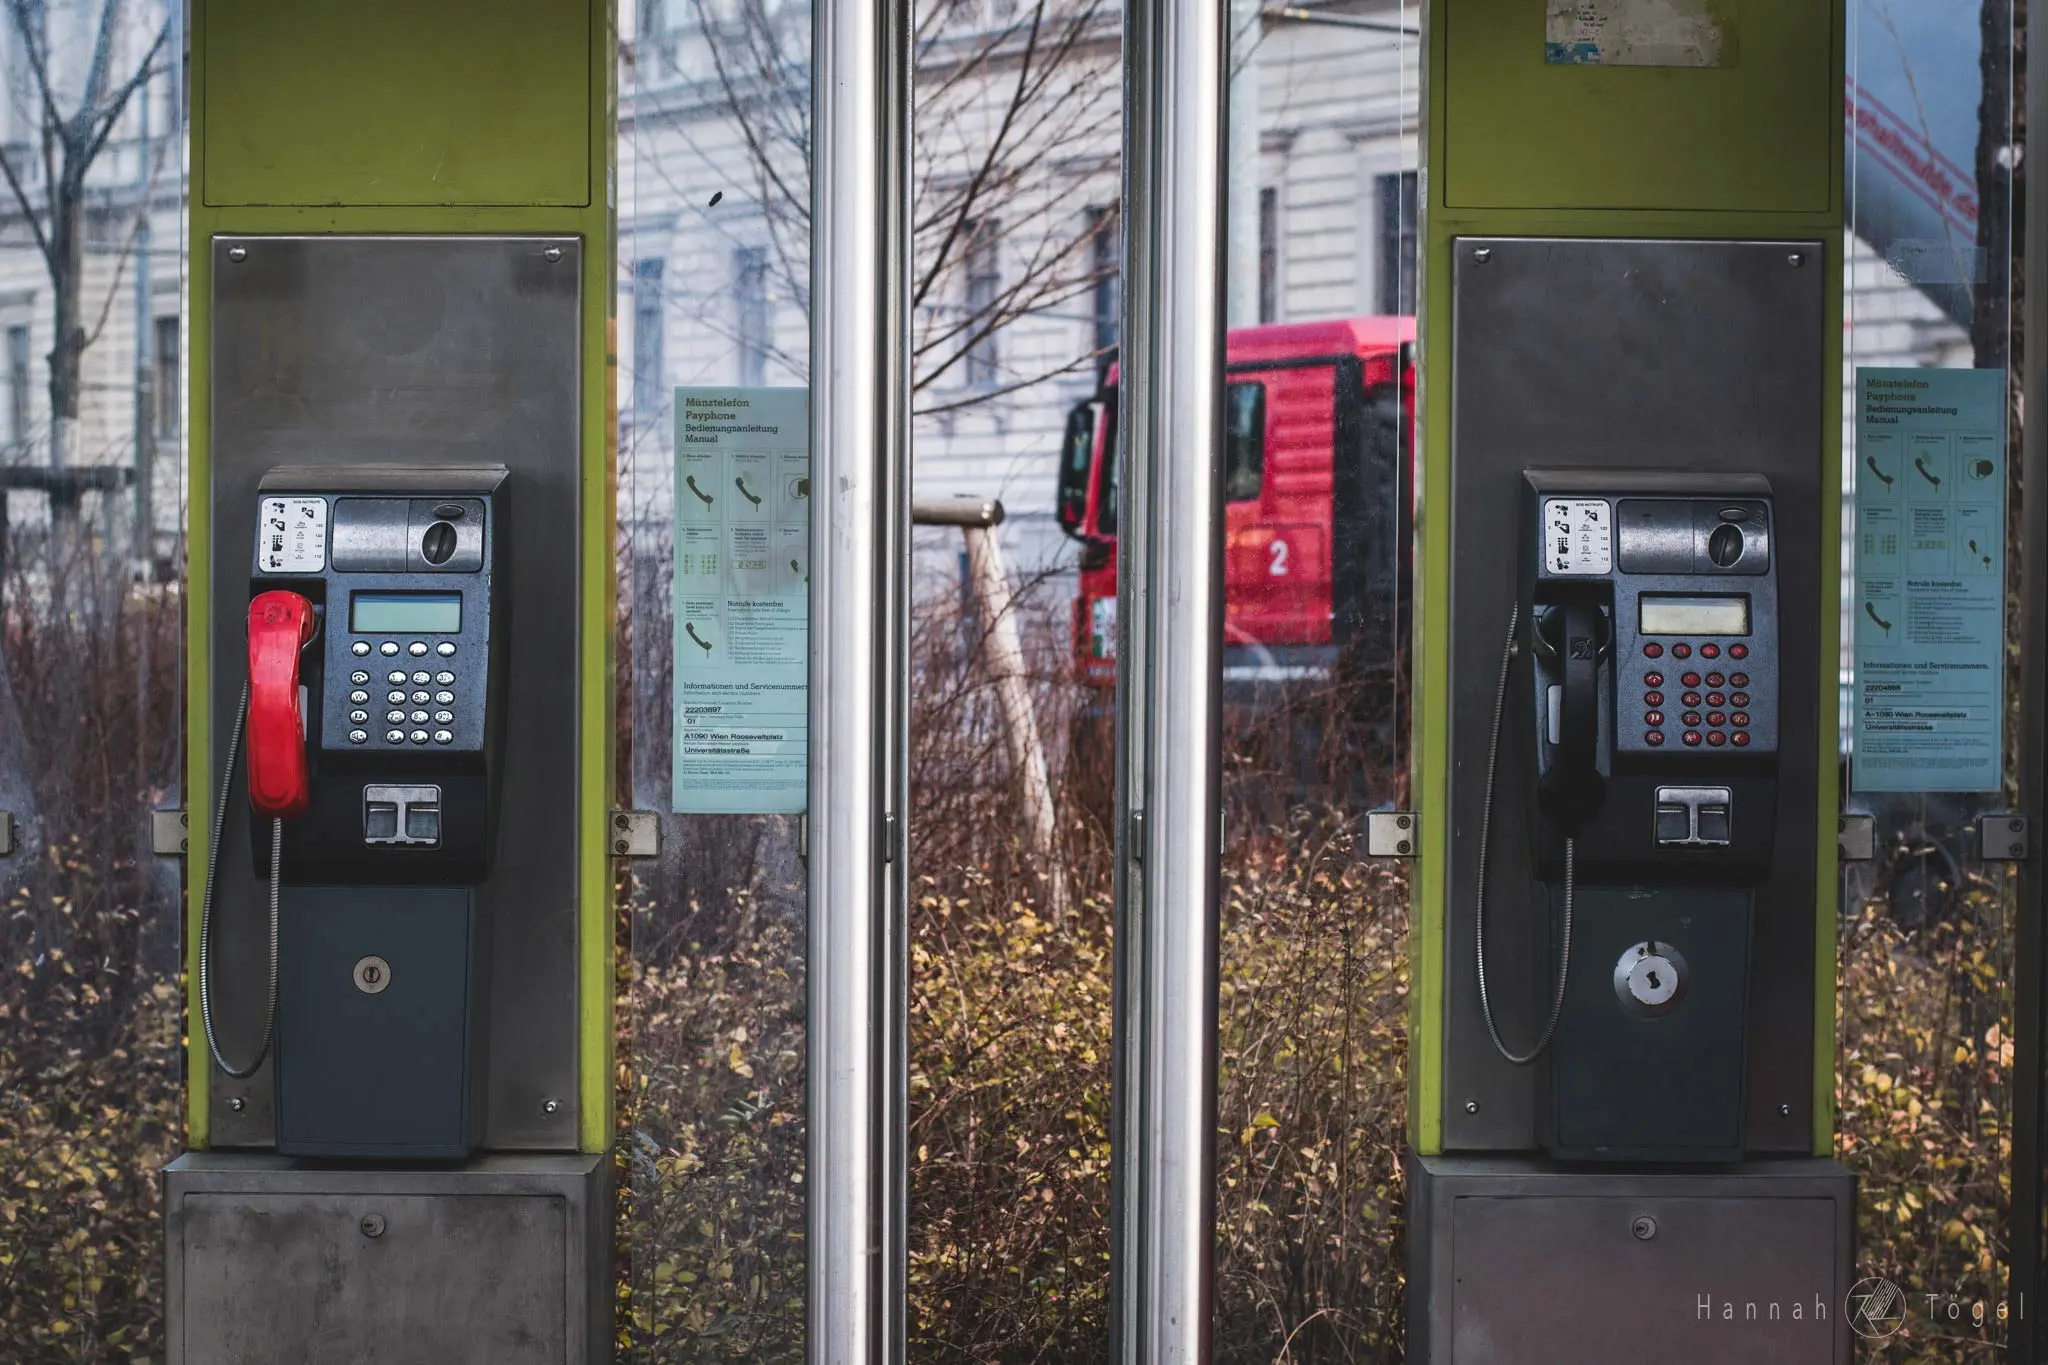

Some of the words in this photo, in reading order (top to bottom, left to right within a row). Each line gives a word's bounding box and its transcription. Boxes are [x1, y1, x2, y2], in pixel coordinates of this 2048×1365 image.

[1866, 378, 1929, 389] Münztelefon
[1866, 392, 1916, 402] Payphone
[685, 396, 749, 408] Münztelefon
[1866, 404, 1957, 415] Bedienungsanleitung
[685, 411, 736, 422] Payphone
[1866, 415, 1899, 424] Manual
[685, 424, 778, 434] Bedienungsanleitung
[685, 434, 718, 443] Manual
[1270, 539, 1288, 576] 2
[752, 600, 784, 608] kostenfrei
[1863, 661, 1912, 669] Informationen
[1914, 661, 1928, 669] und
[684, 682, 733, 690] Informationen
[734, 682, 749, 690] und
[730, 733, 784, 741] Rooseveltplatz
[684, 747, 751, 755] Universitätsstraße
